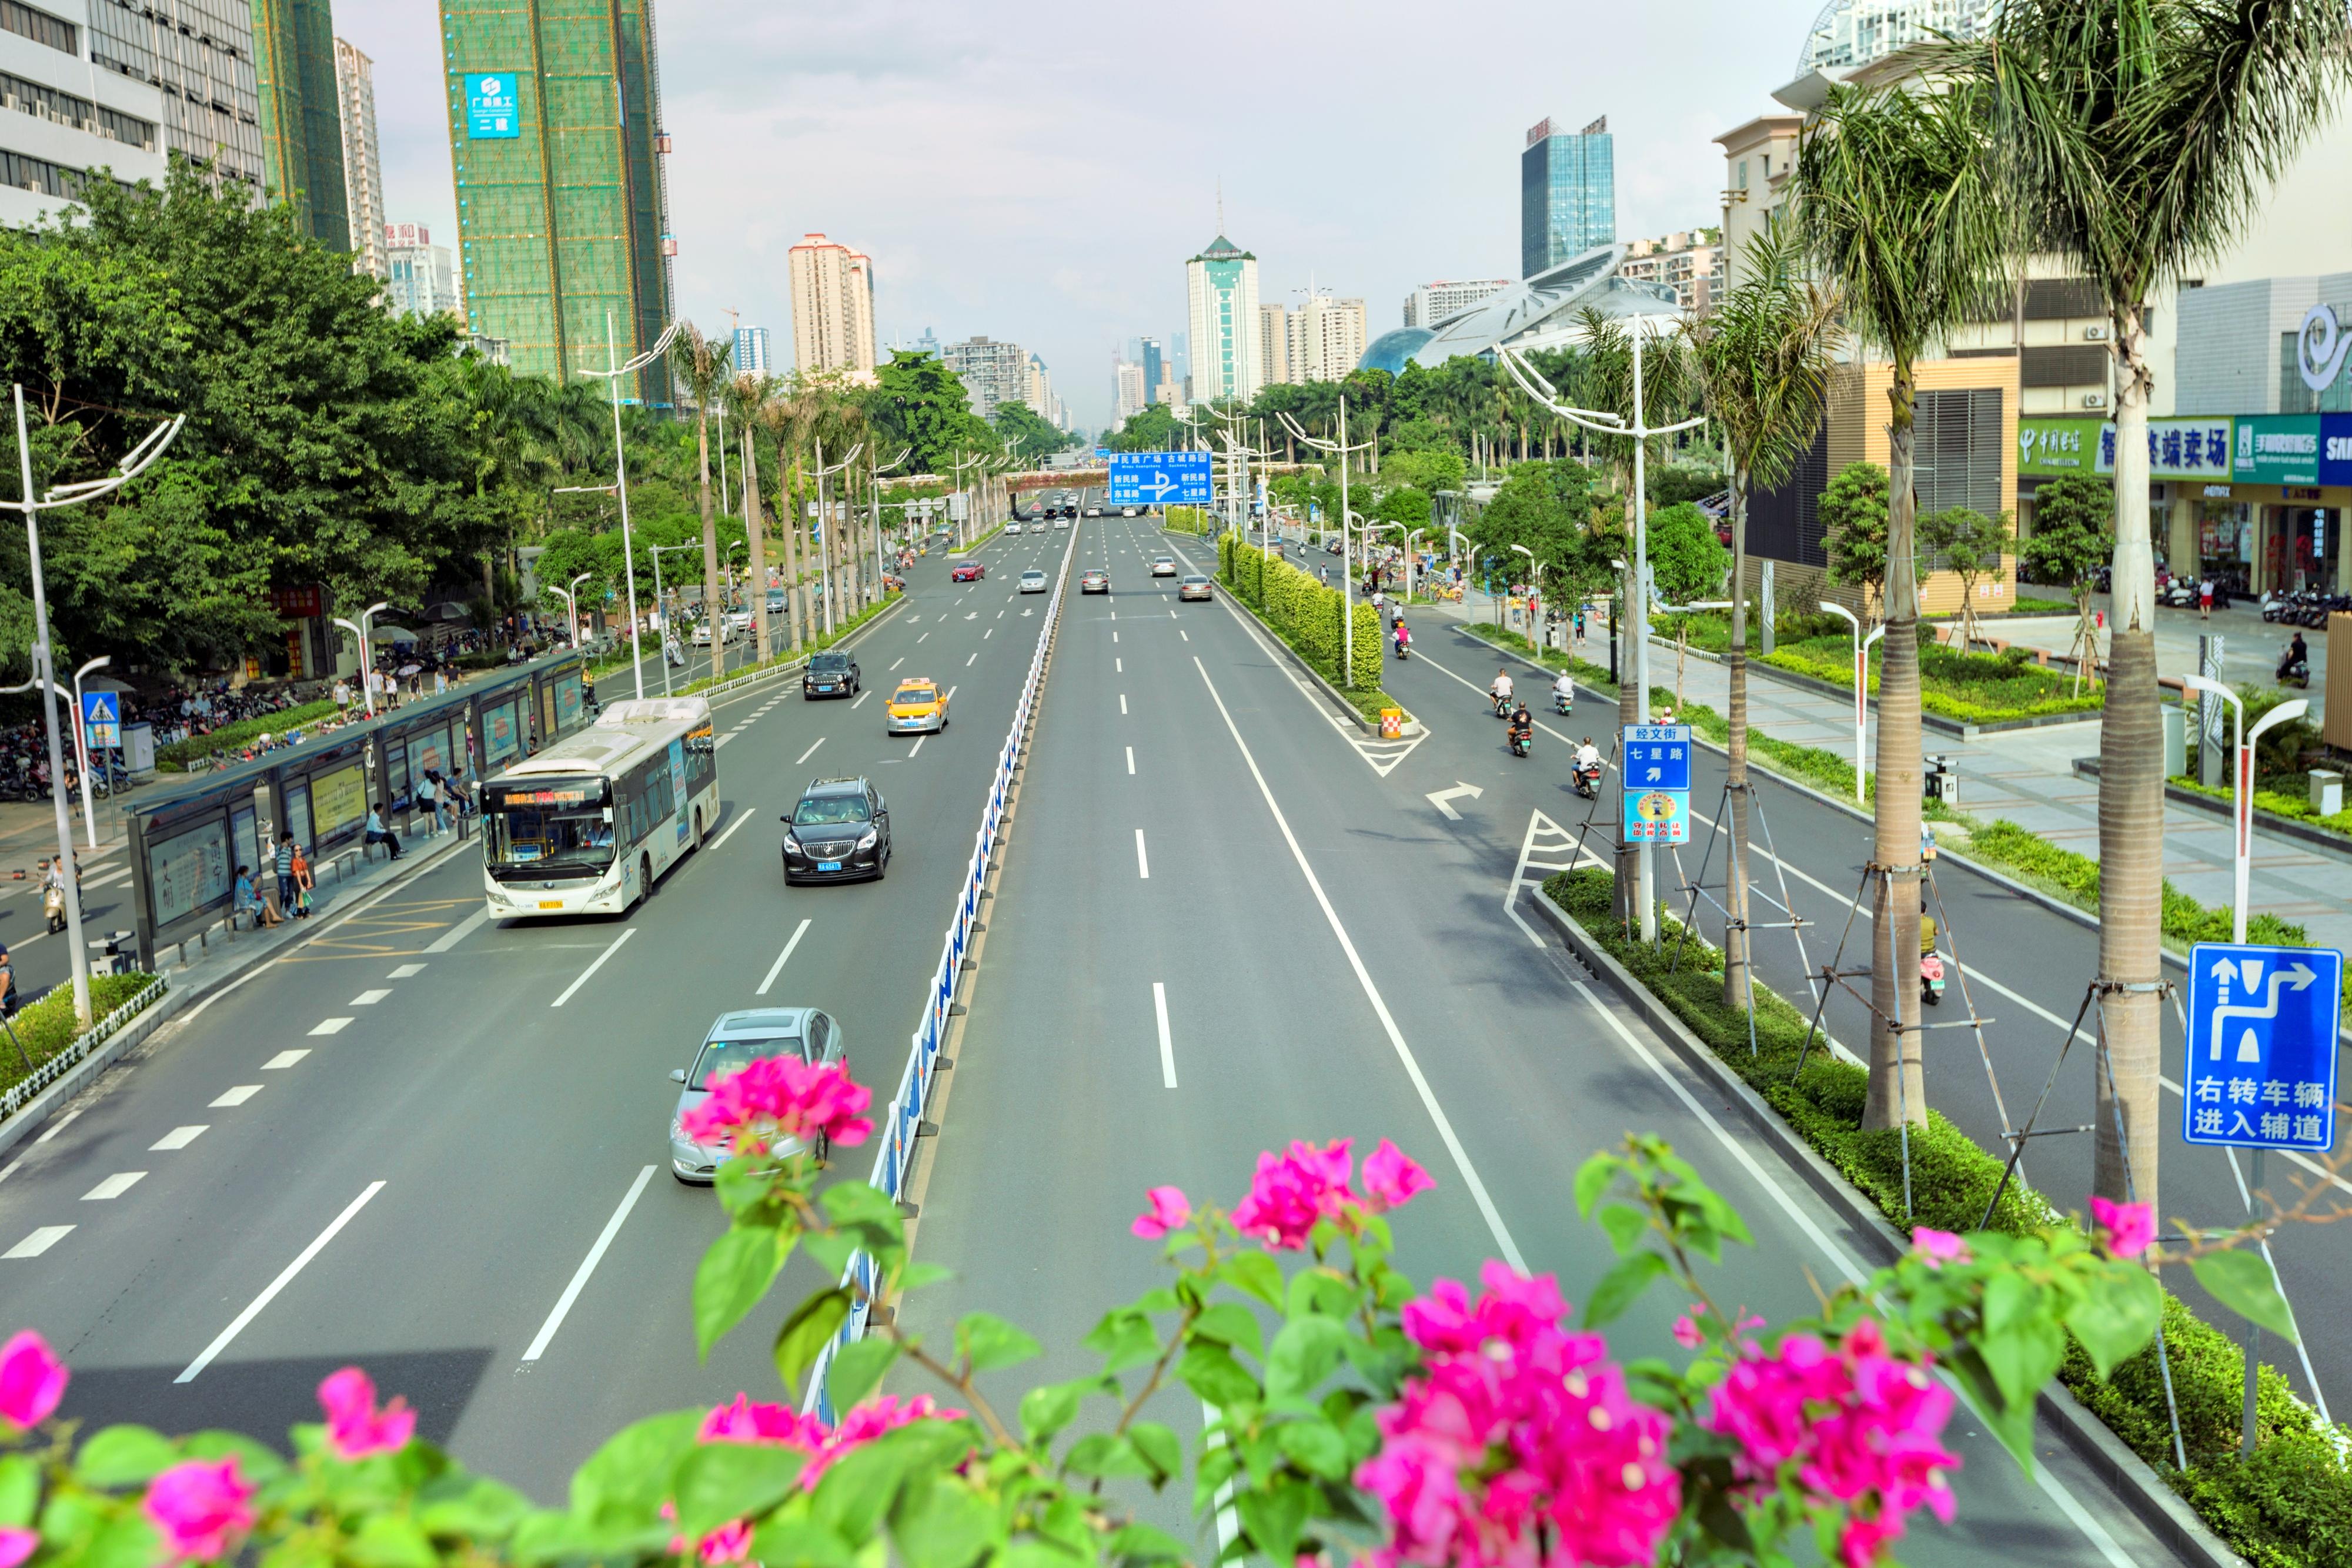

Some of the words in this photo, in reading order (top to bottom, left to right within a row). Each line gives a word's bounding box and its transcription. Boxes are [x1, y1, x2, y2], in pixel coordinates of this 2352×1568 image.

[2040, 429, 2080, 454] 中国电信
[2102, 429, 2226, 467] 智终端卖场
[1121, 455, 1161, 463] 民族广场
[1168, 454, 1197, 463] 古城路
[1114, 475, 1139, 483] 新民路
[1181, 473, 1206, 482] 新民路
[1114, 490, 1140, 498] 东葛路
[1182, 488, 1207, 497] 七星路
[1636, 728, 1676, 740] 经文街
[1630, 748, 1683, 760] 七星路
[2196, 1075, 2324, 1109] 右转车辆
[2194, 1108, 2323, 1142] 进入辅道
